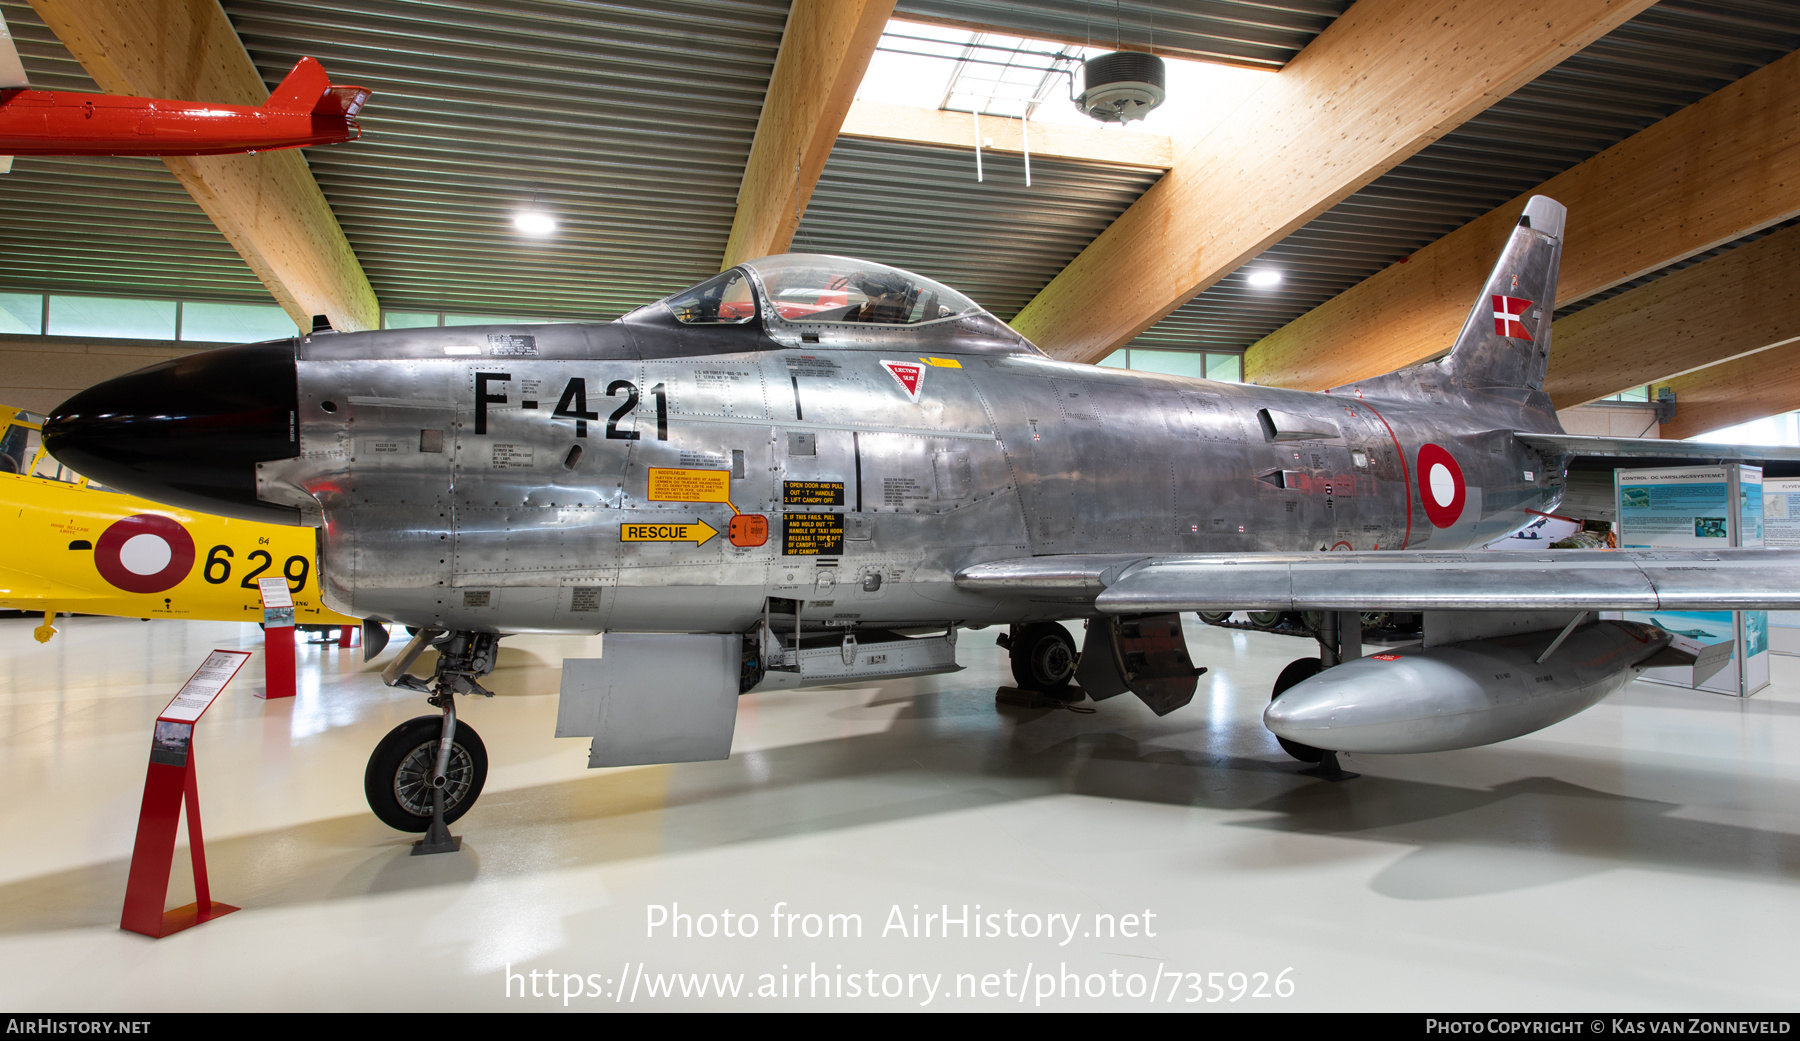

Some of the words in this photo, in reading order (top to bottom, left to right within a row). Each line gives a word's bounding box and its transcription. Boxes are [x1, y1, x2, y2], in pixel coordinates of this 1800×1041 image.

[475, 372, 668, 441] F-421
[258, 536, 270, 545] 64
[628, 527, 687, 538] RESCUE
[204, 544, 310, 593] 629
